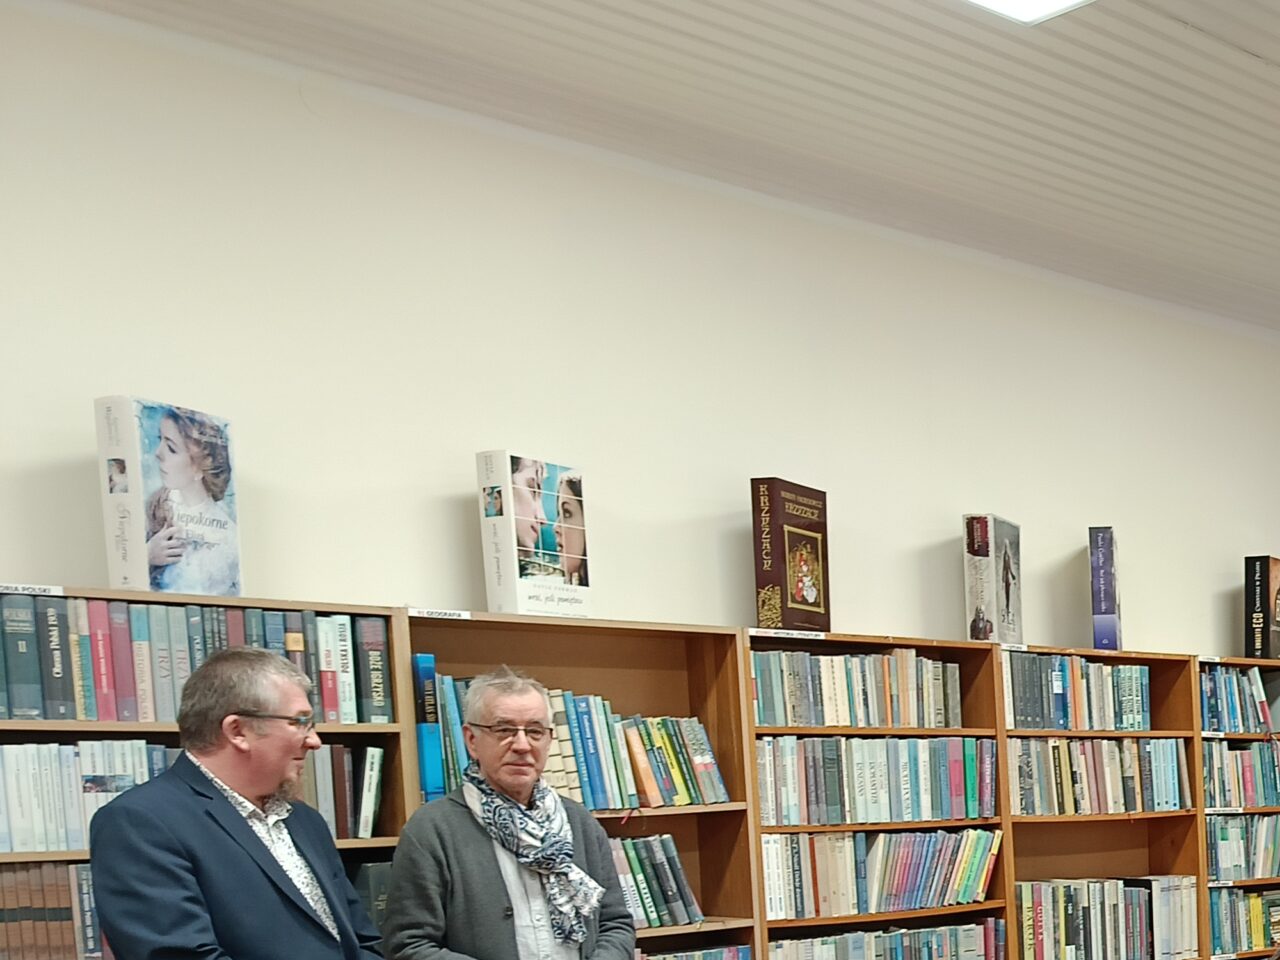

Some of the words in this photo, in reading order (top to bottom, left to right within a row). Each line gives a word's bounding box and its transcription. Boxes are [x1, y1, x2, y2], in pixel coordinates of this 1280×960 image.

[22, 587, 51, 595] POLSKI
[47, 608, 58, 625] 1939
[426, 610, 462, 618] GEOGRAFIA
[1252, 612, 1264, 627] ECO
[48, 627, 60, 649] Polski
[337, 623, 347, 642] ROSJA
[52, 649, 63, 678] Obrona
[340, 649, 351, 674] POLSKA
[368, 651, 384, 669] BOŻE
[369, 671, 385, 707] IGRZYSKO
[424, 696, 434, 713] ATLAS
[855, 762, 865, 797] RENESANS
[868, 761, 878, 804] ROMANTYZM
